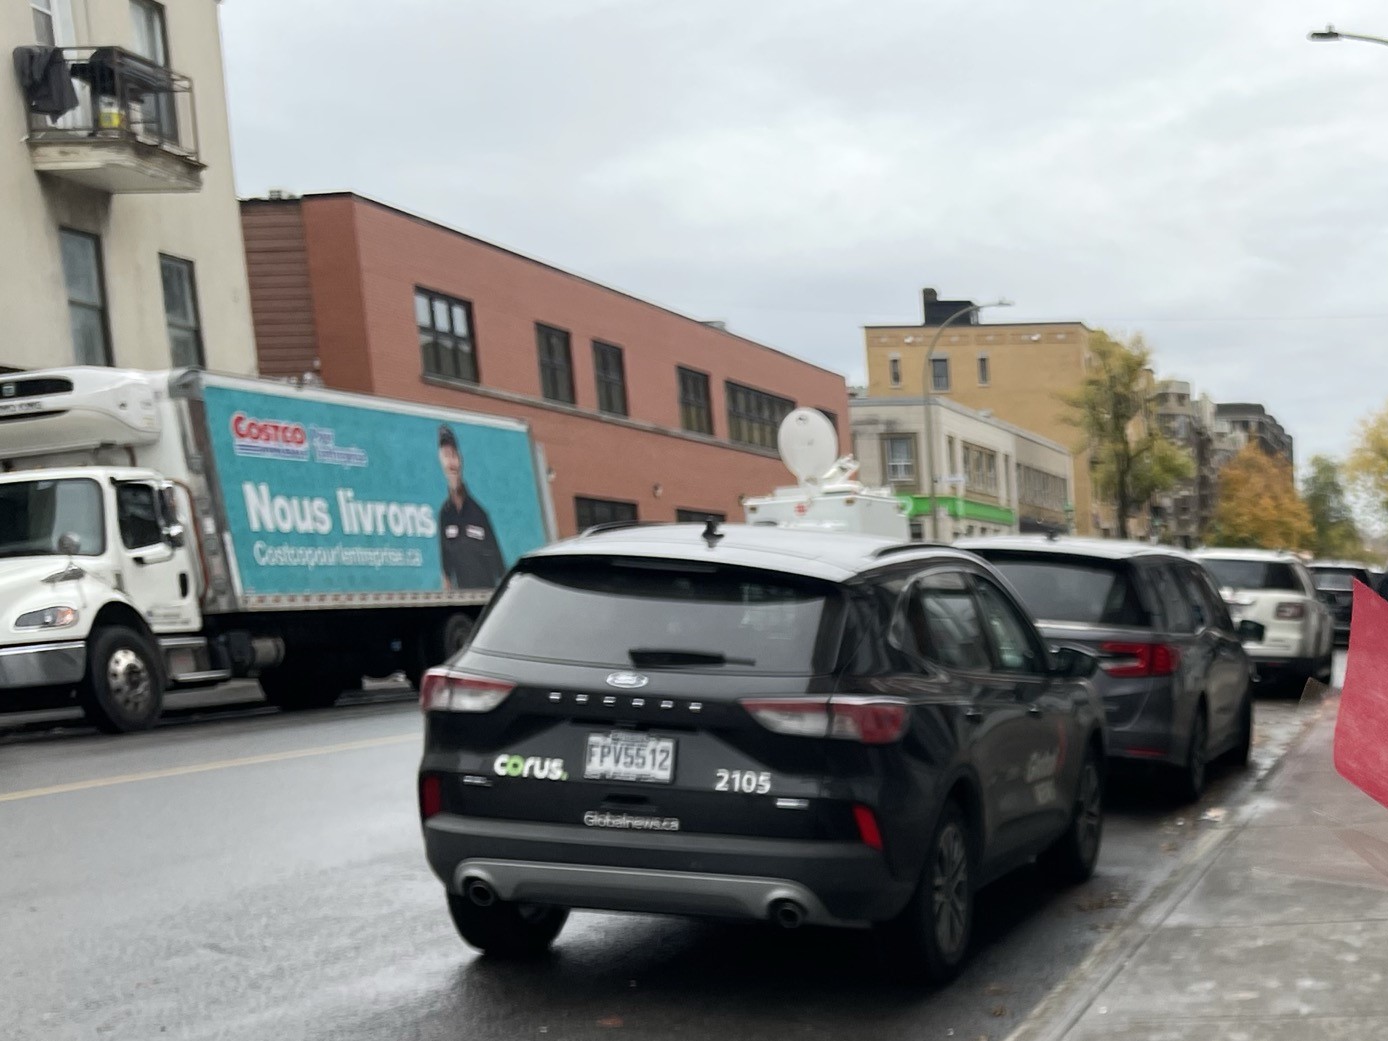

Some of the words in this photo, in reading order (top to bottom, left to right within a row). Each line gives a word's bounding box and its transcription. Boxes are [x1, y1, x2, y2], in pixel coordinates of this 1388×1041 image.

[242, 481, 332, 534] Nous
[336, 488, 438, 537] livrons
[587, 743, 671, 772] FPV5512
[714, 768, 771, 794] 2105
[583, 810, 680, 831] Globalnews.ca
